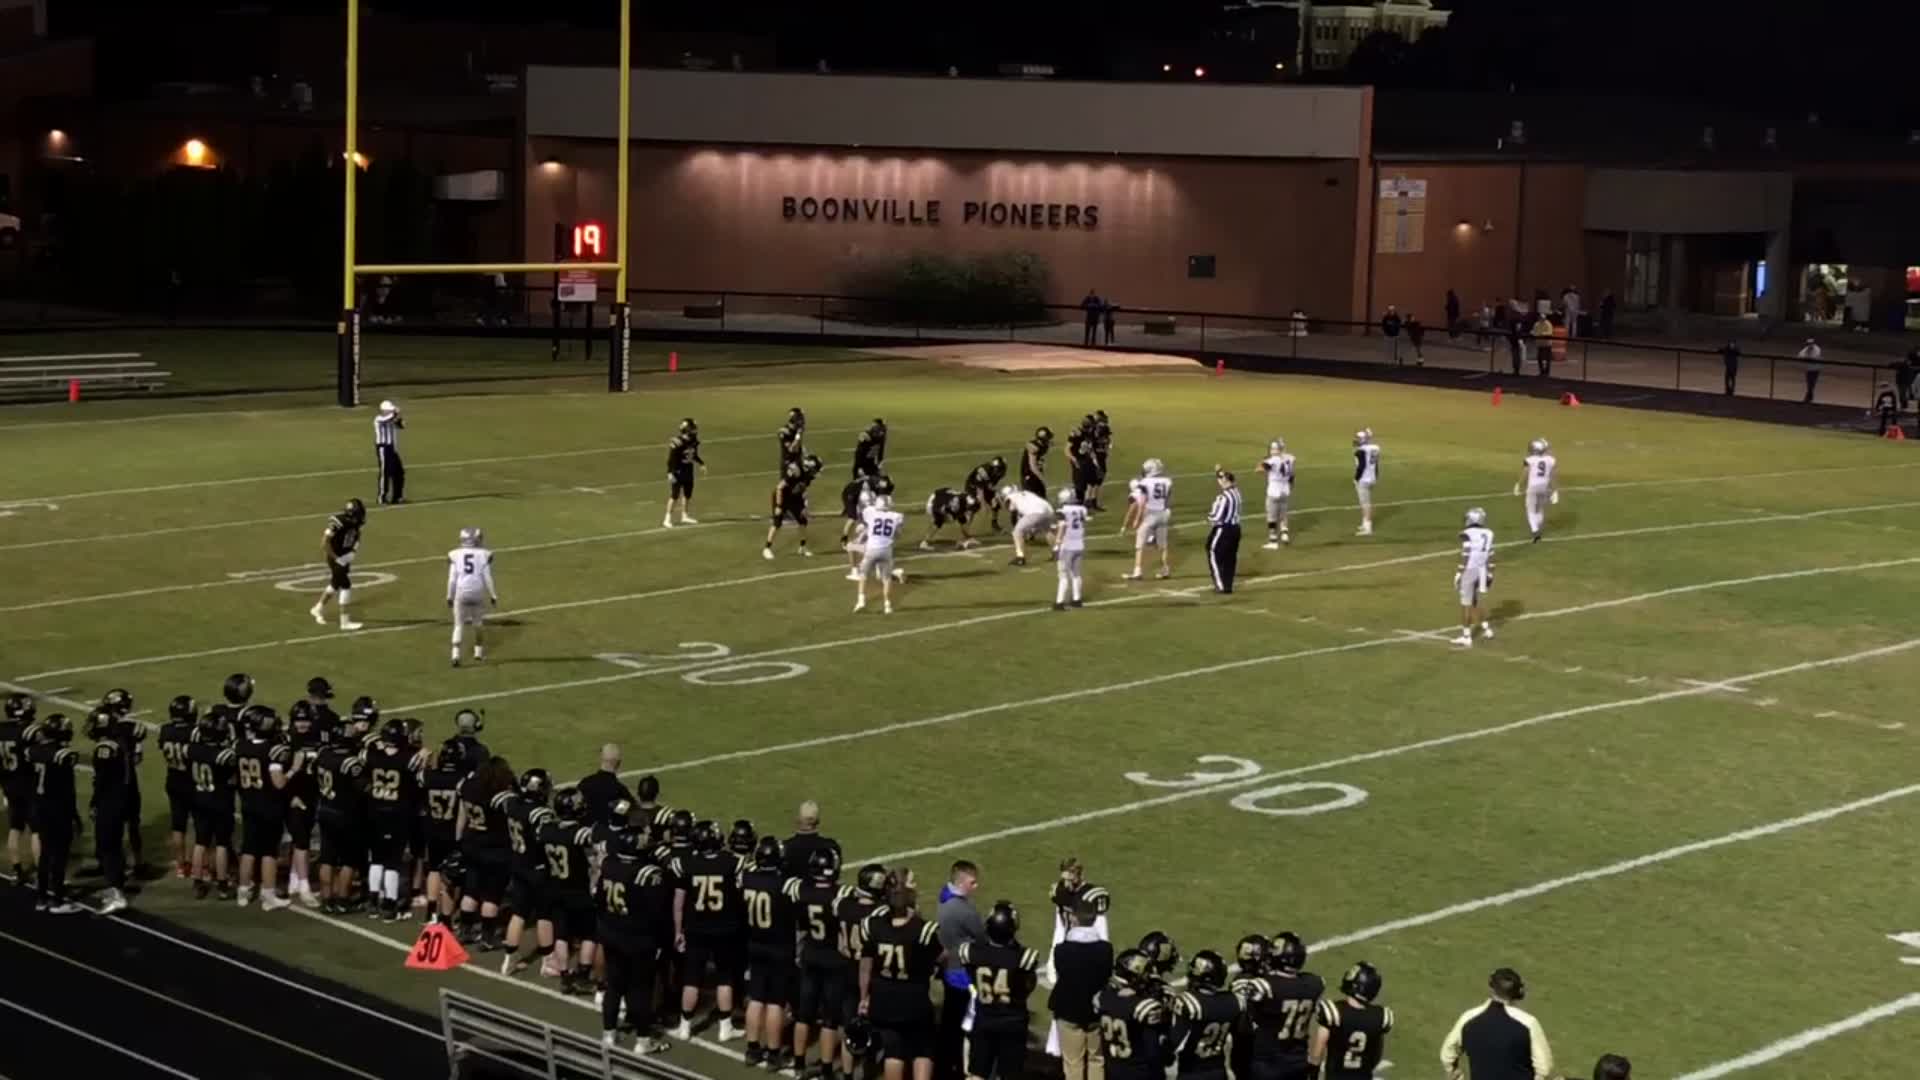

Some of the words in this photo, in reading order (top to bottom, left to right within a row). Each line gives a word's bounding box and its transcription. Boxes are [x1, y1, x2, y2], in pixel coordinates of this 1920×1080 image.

[782, 197, 940, 224] BOONVILLE
[963, 201, 1098, 227] PIONEERS
[574, 225, 600, 255] 19
[873, 518, 893, 536] 26
[464, 554, 474, 574] 5
[592, 641, 810, 686] 20
[1123, 755, 1369, 816] 30
[428, 789, 456, 820] 57
[692, 876, 724, 911] 75
[744, 889, 772, 928] 70
[808, 904, 825, 940] 5
[416, 931, 443, 963] 30
[878, 943, 908, 979] 71
[976, 966, 1010, 1004] 64
[1344, 1031, 1367, 1068] 2
